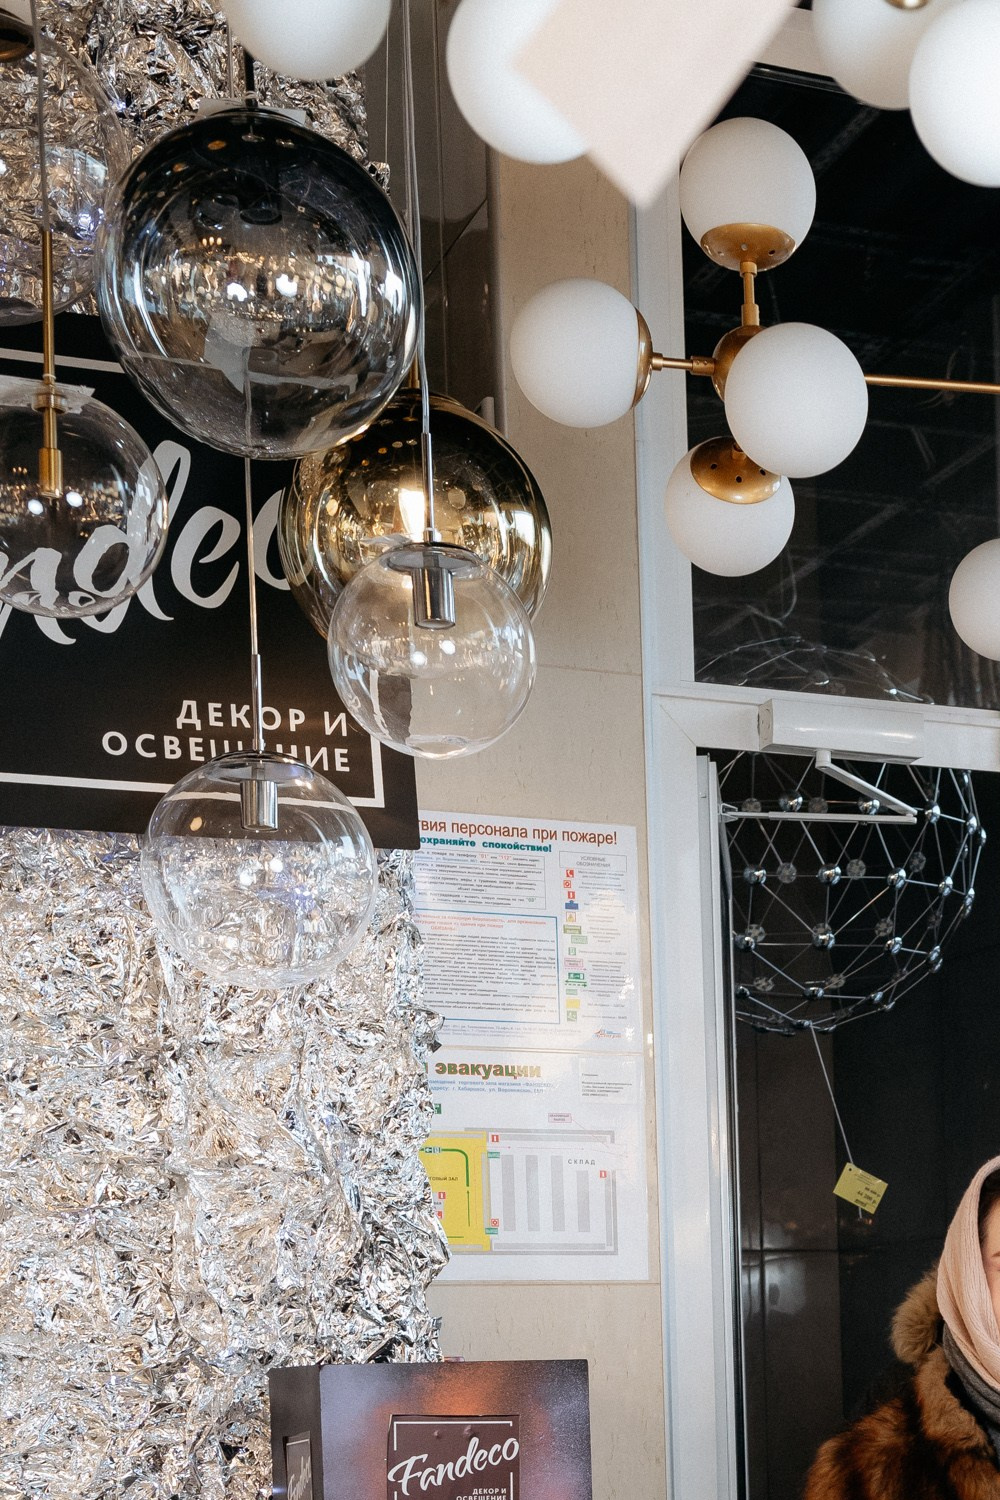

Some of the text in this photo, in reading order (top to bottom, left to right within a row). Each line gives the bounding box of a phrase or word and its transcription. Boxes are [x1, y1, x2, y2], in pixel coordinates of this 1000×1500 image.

[176, 700, 348, 737] ДЕКОР И
[418, 819, 618, 845] вия персонала при пожаре!
[482, 840, 552, 853] спокойствие!
[435, 1062, 542, 1080] эвакуации
[388, 1436, 520, 1496] Fandeco
[472, 1488, 500, 1496] ДЕКОР
